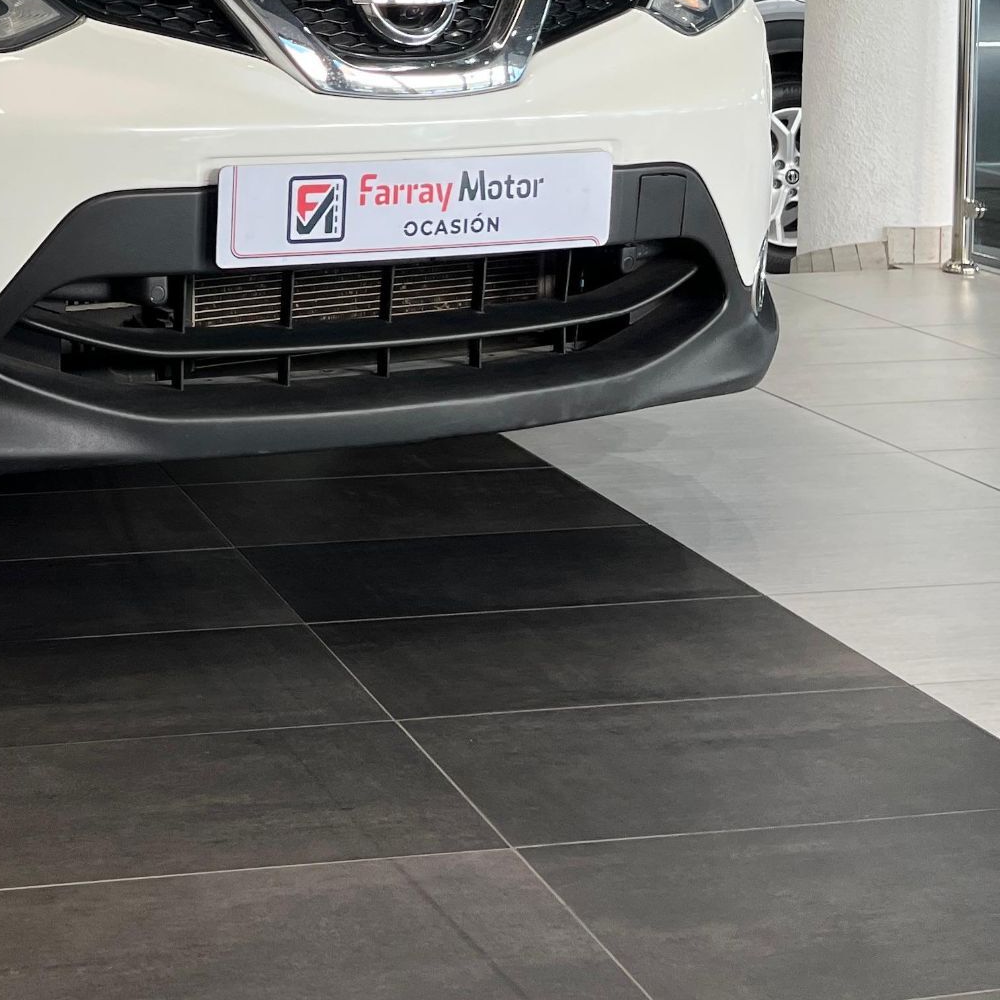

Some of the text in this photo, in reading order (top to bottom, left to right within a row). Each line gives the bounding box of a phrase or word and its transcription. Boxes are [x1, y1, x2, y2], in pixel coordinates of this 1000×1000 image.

[359, 170, 545, 213] Farray Motor
[403, 212, 500, 237] OCASIÓN
